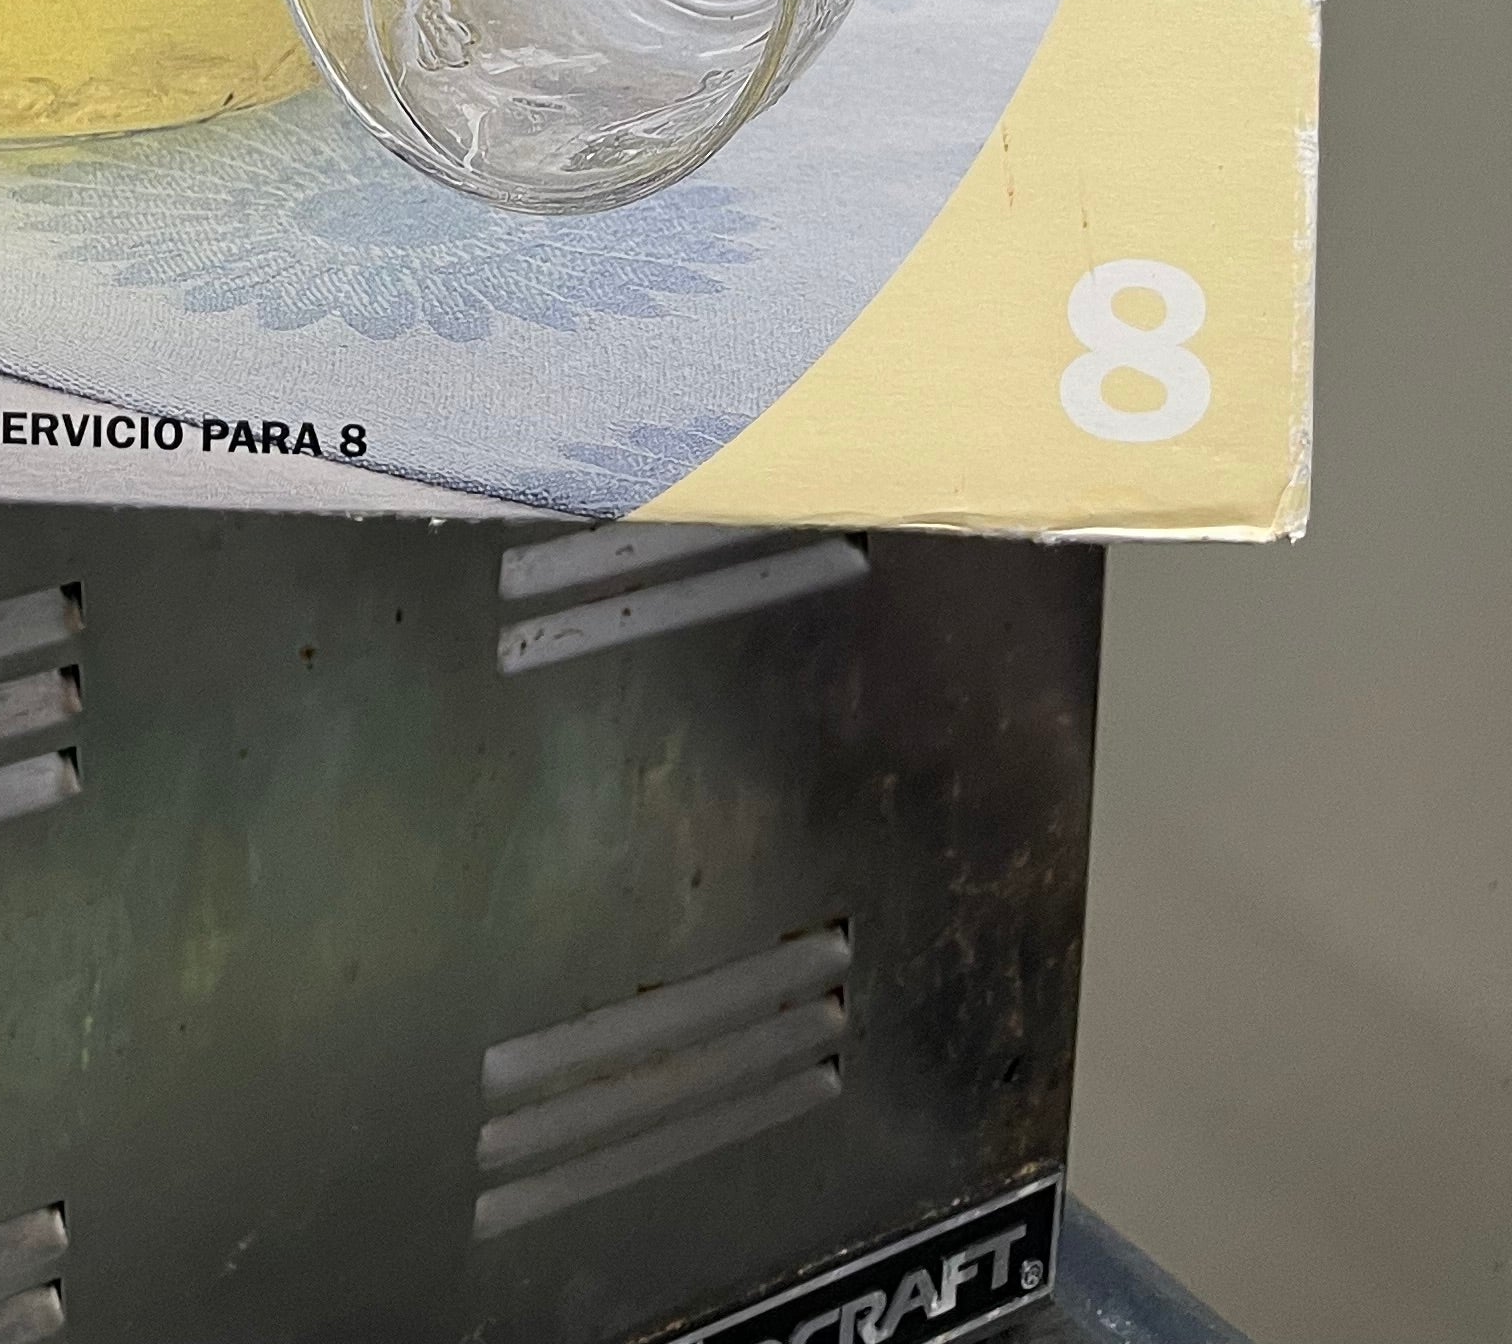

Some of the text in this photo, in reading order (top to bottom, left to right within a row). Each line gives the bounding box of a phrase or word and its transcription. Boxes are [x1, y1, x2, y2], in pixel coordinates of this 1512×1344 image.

[1060, 258, 1211, 441] 8
[201, 418, 323, 458] PARA
[339, 423, 368, 459] 8
